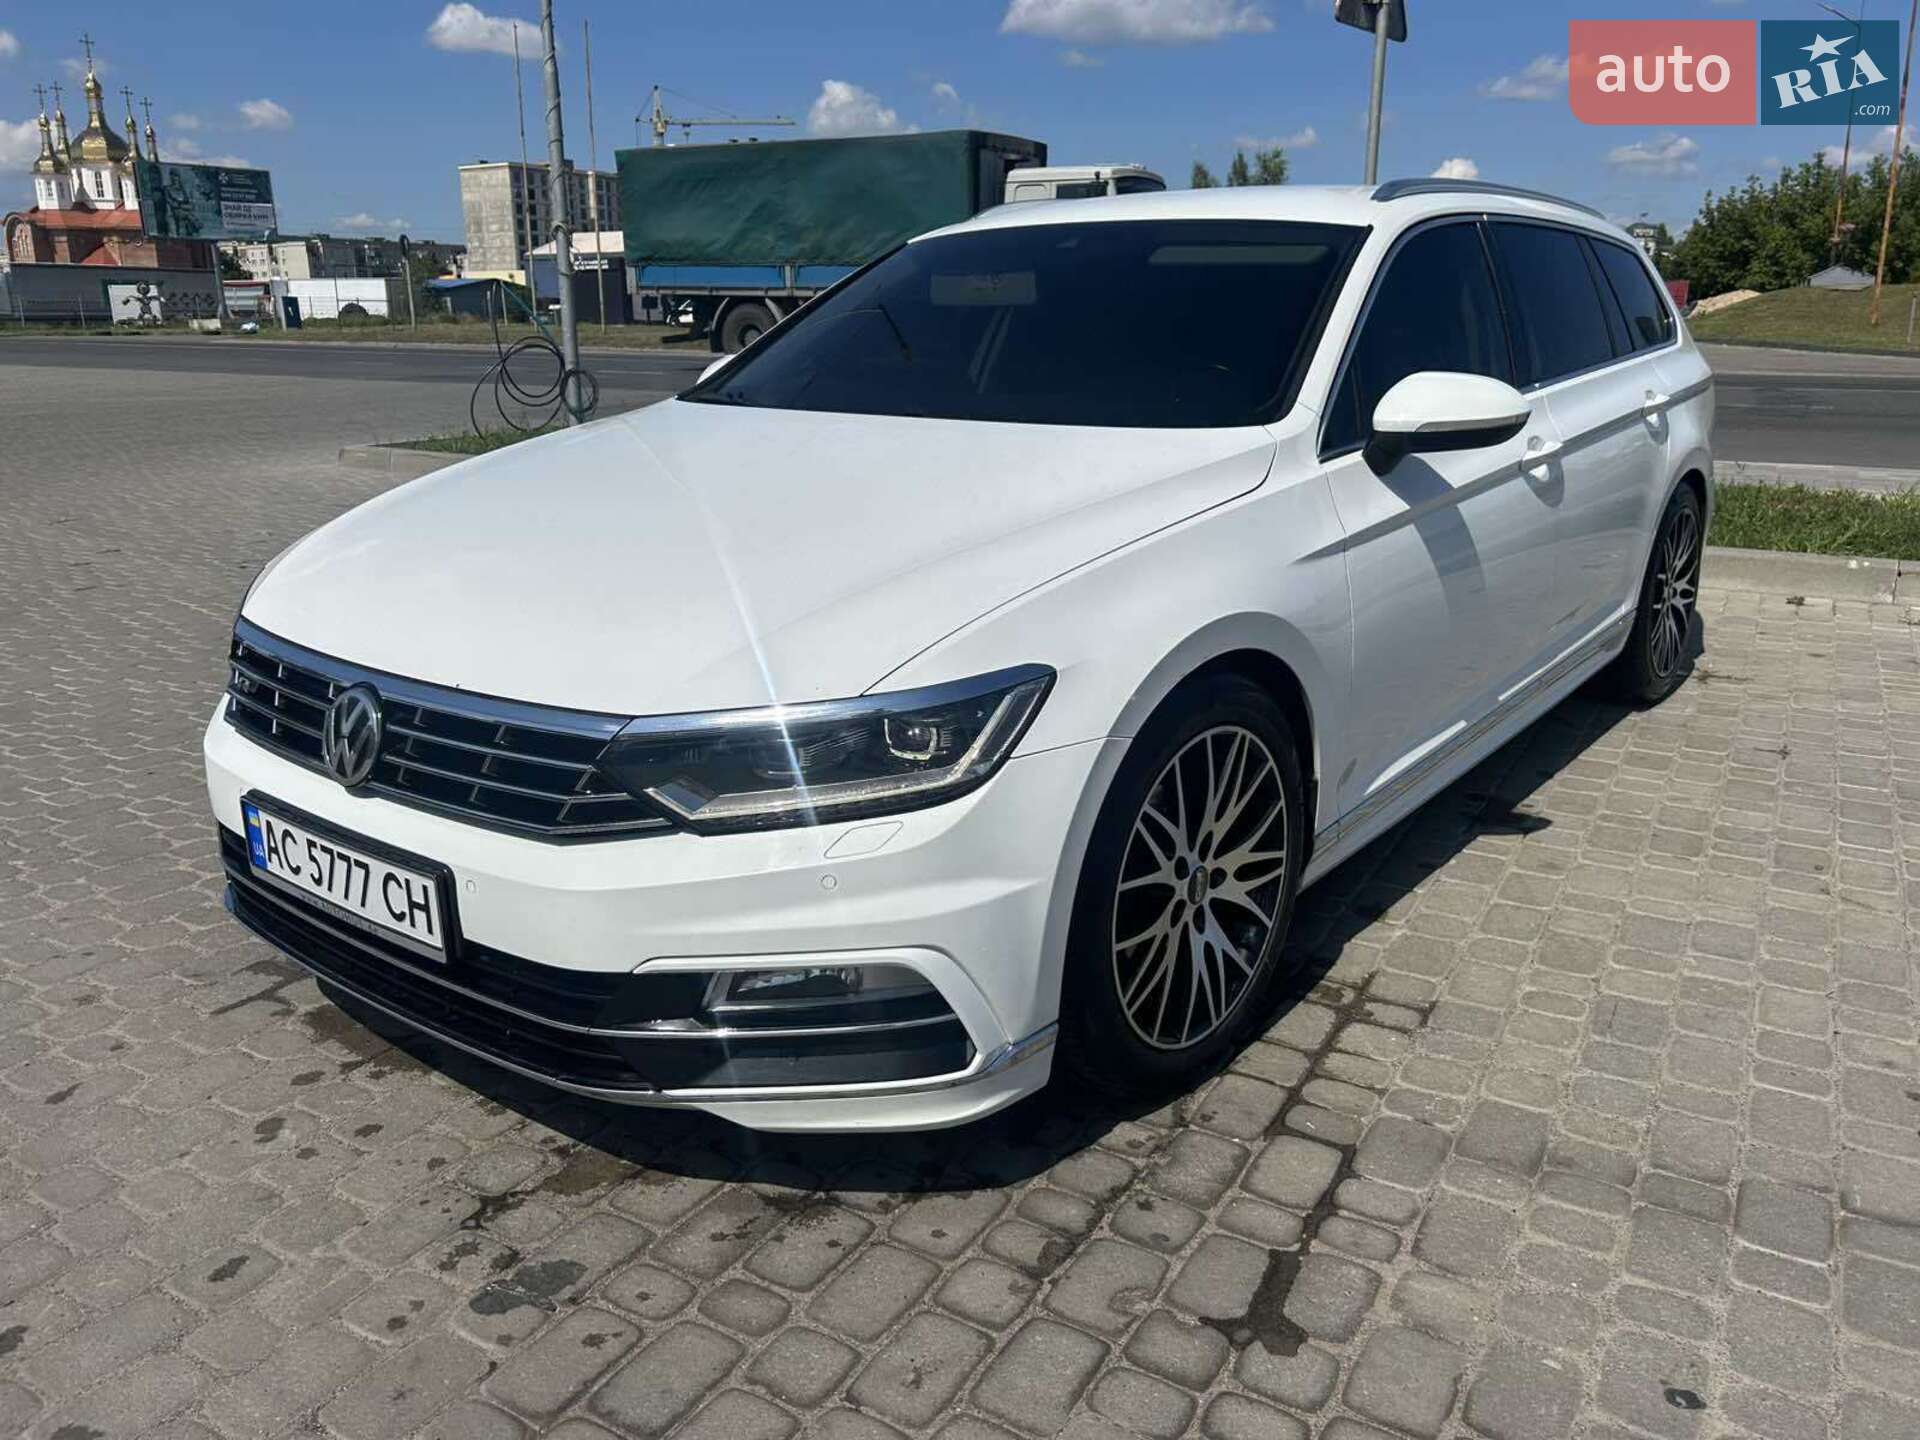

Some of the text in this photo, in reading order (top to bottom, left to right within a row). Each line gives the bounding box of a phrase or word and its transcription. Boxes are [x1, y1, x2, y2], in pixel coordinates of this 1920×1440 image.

[265, 819, 301, 876] AC
[306, 837, 370, 908] 5777
[382, 871, 434, 936] CH
